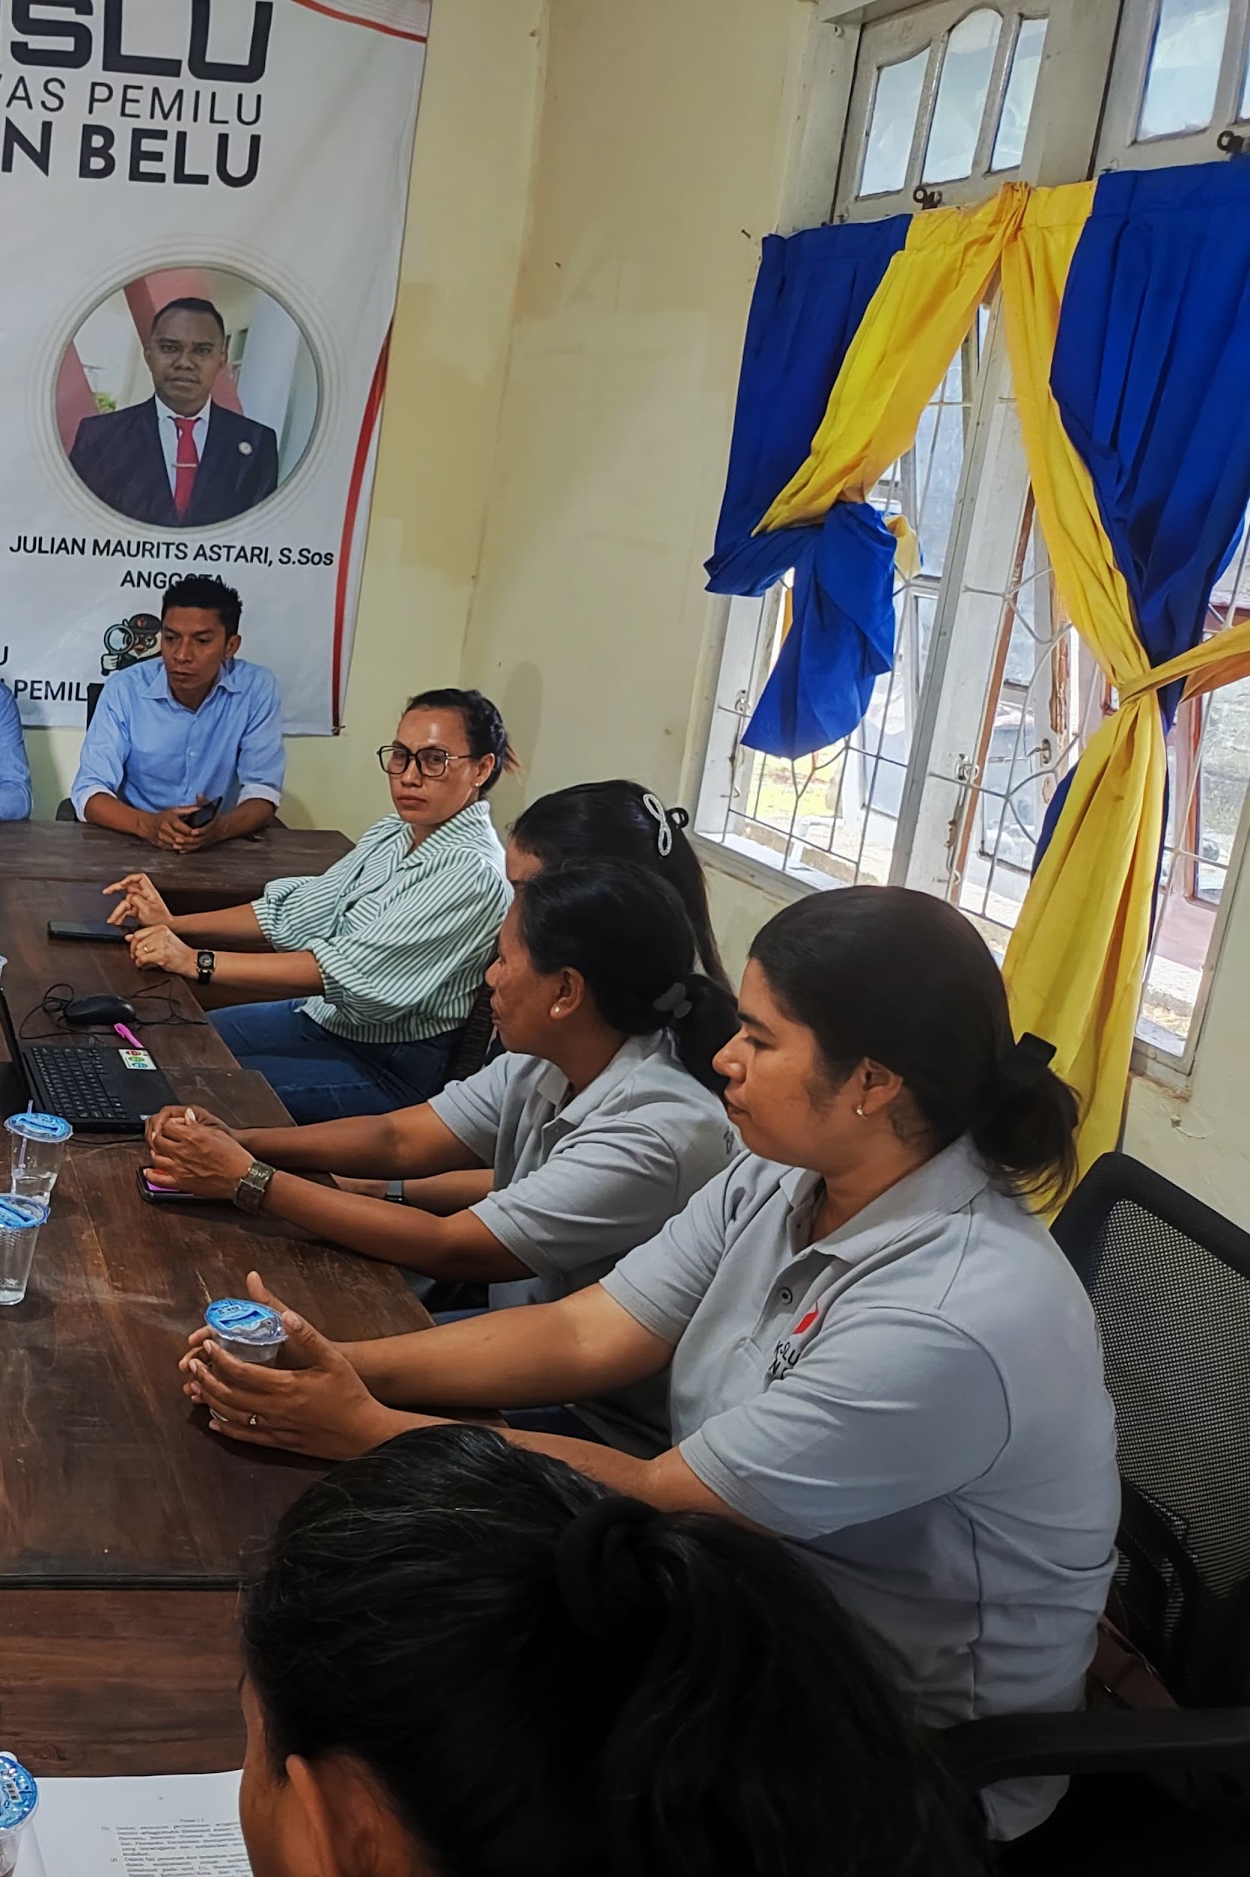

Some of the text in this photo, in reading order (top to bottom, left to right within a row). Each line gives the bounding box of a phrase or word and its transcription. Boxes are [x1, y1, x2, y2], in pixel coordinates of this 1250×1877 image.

[89, 81, 263, 126] PEMILU
[78, 123, 261, 188] BELU
[9, 535, 334, 567] JULIAN MAURITS ASTARI, S.Sos
[13, 679, 88, 702] PEMIL
